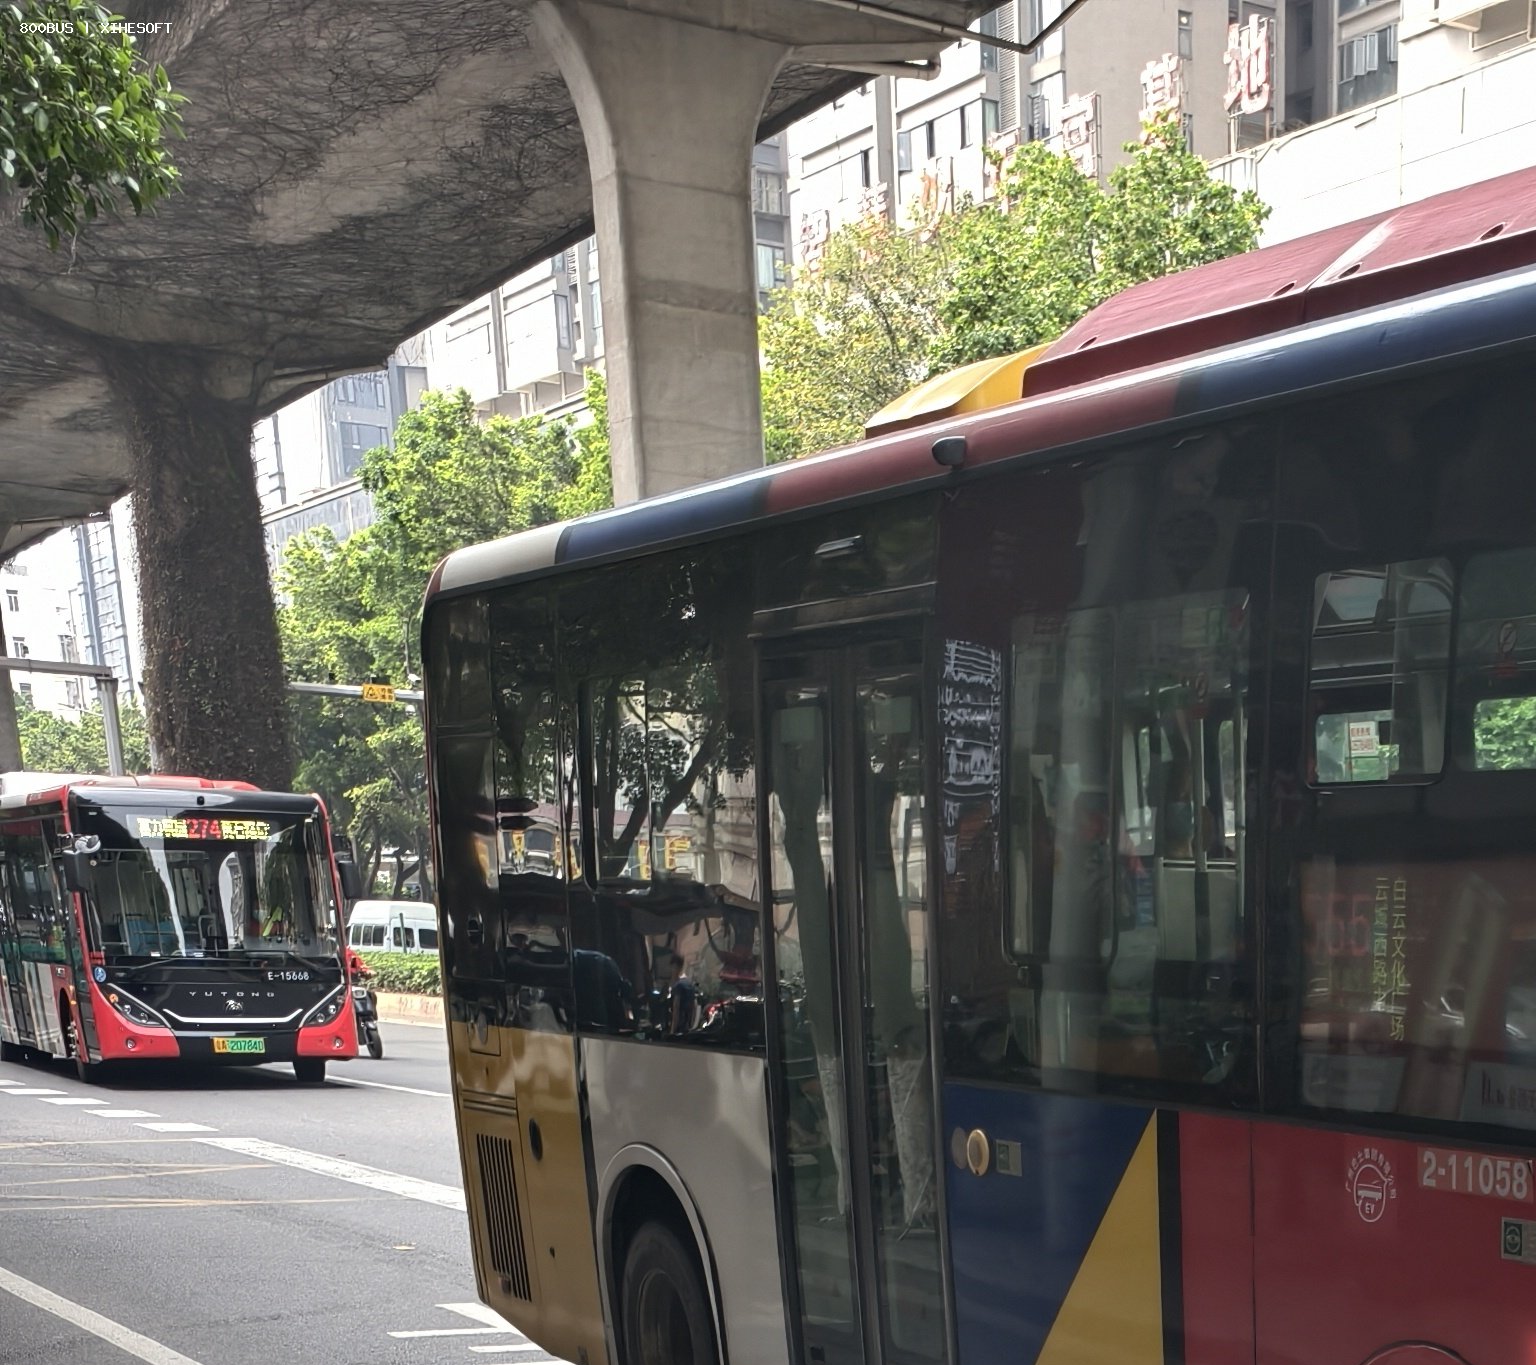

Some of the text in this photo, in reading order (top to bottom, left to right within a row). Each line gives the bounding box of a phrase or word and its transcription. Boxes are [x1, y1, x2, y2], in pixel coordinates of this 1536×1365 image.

[186, 818, 222, 839] 274
[267, 971, 310, 981] E-15668
[1390, 876, 1411, 1041] 白云文化广场
[1421, 1150, 1528, 1200] 2-11058
